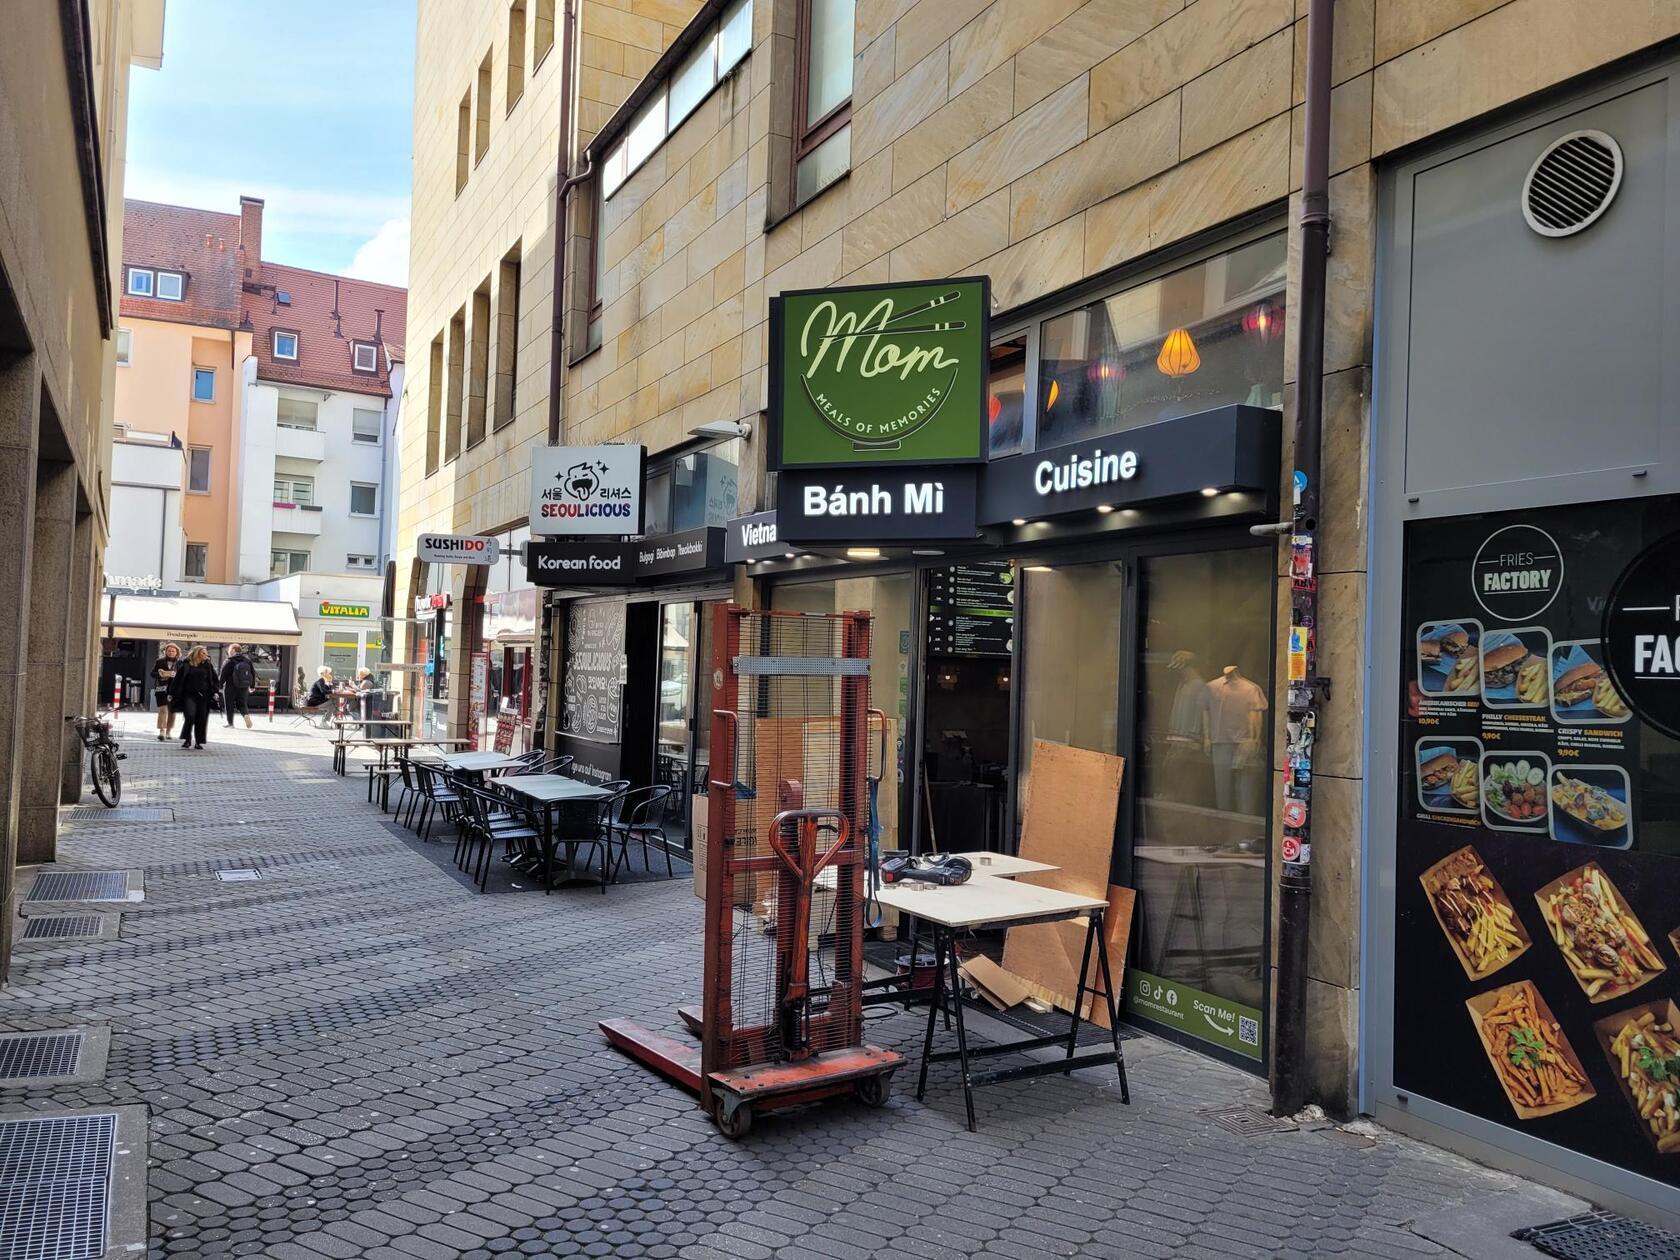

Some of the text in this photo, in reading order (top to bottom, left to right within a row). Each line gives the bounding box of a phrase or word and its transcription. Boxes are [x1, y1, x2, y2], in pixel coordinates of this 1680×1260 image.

[801, 298, 959, 380] Mom
[816, 387, 941, 434] MEALS OF MEMORIES
[1035, 449, 1137, 495] Cuisine
[541, 486, 632, 501] 서울 리셔스
[803, 482, 945, 517] Bánh Mì
[541, 503, 631, 518] SEOULICIOUS
[425, 537, 485, 552] SUSHIDO
[538, 555, 621, 570] Korean food
[1500, 552, 1534, 567] FRIES
[1484, 569, 1552, 591] FACTORY
[322, 605, 368, 616] VITALIA
[1634, 634, 1680, 673] FA
[1193, 1000, 1236, 1023] Scan Me!
